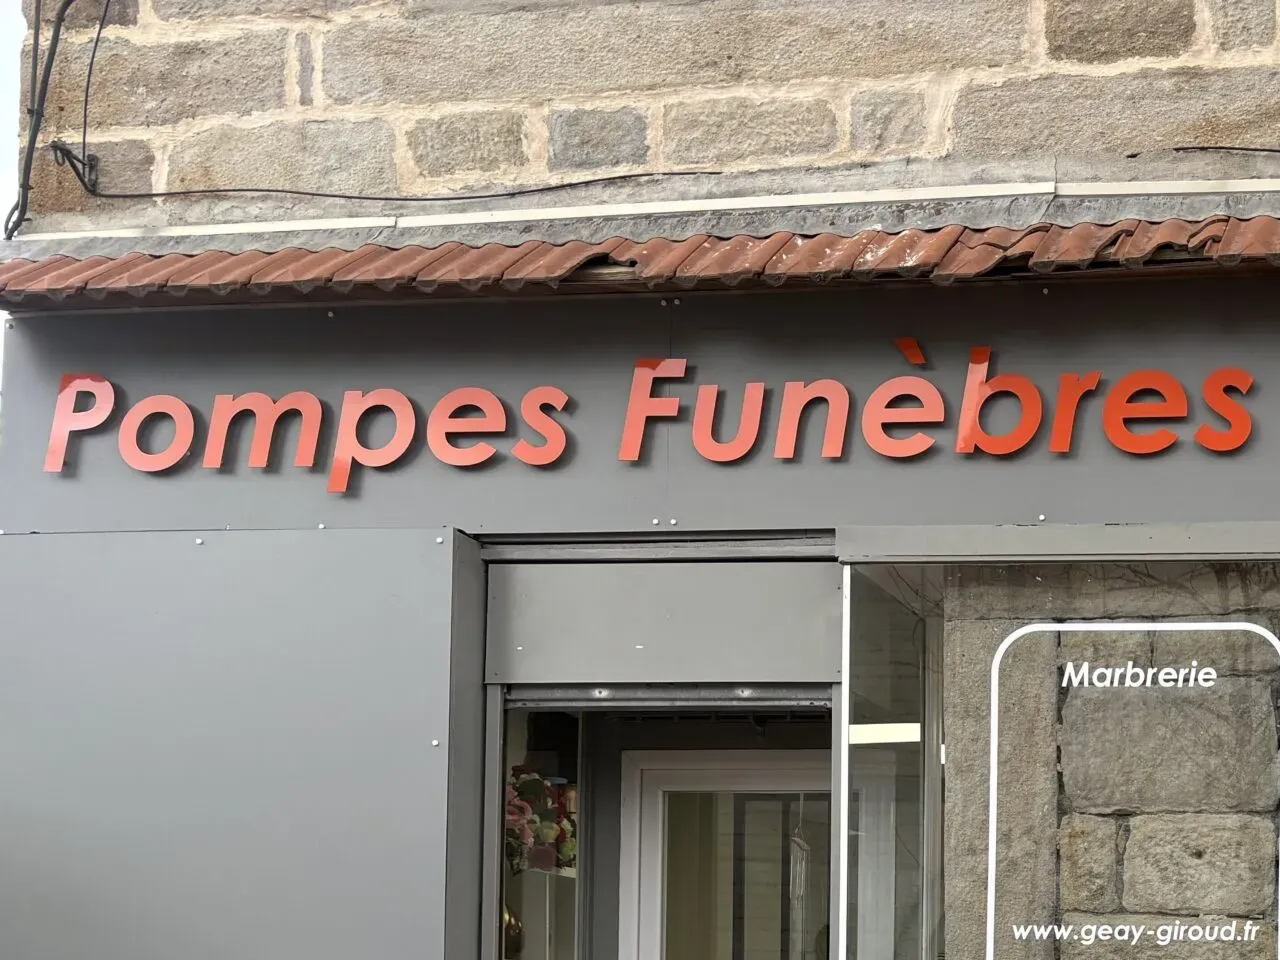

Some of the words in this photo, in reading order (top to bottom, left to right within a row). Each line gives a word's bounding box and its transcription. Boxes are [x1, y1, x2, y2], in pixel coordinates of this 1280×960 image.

[44, 374, 573, 494] Pompes
[618, 337, 1253, 462] Funèbres
[1061, 660, 1218, 688] Marbrerie
[1012, 920, 1260, 946] www.geay-giroud.fr
